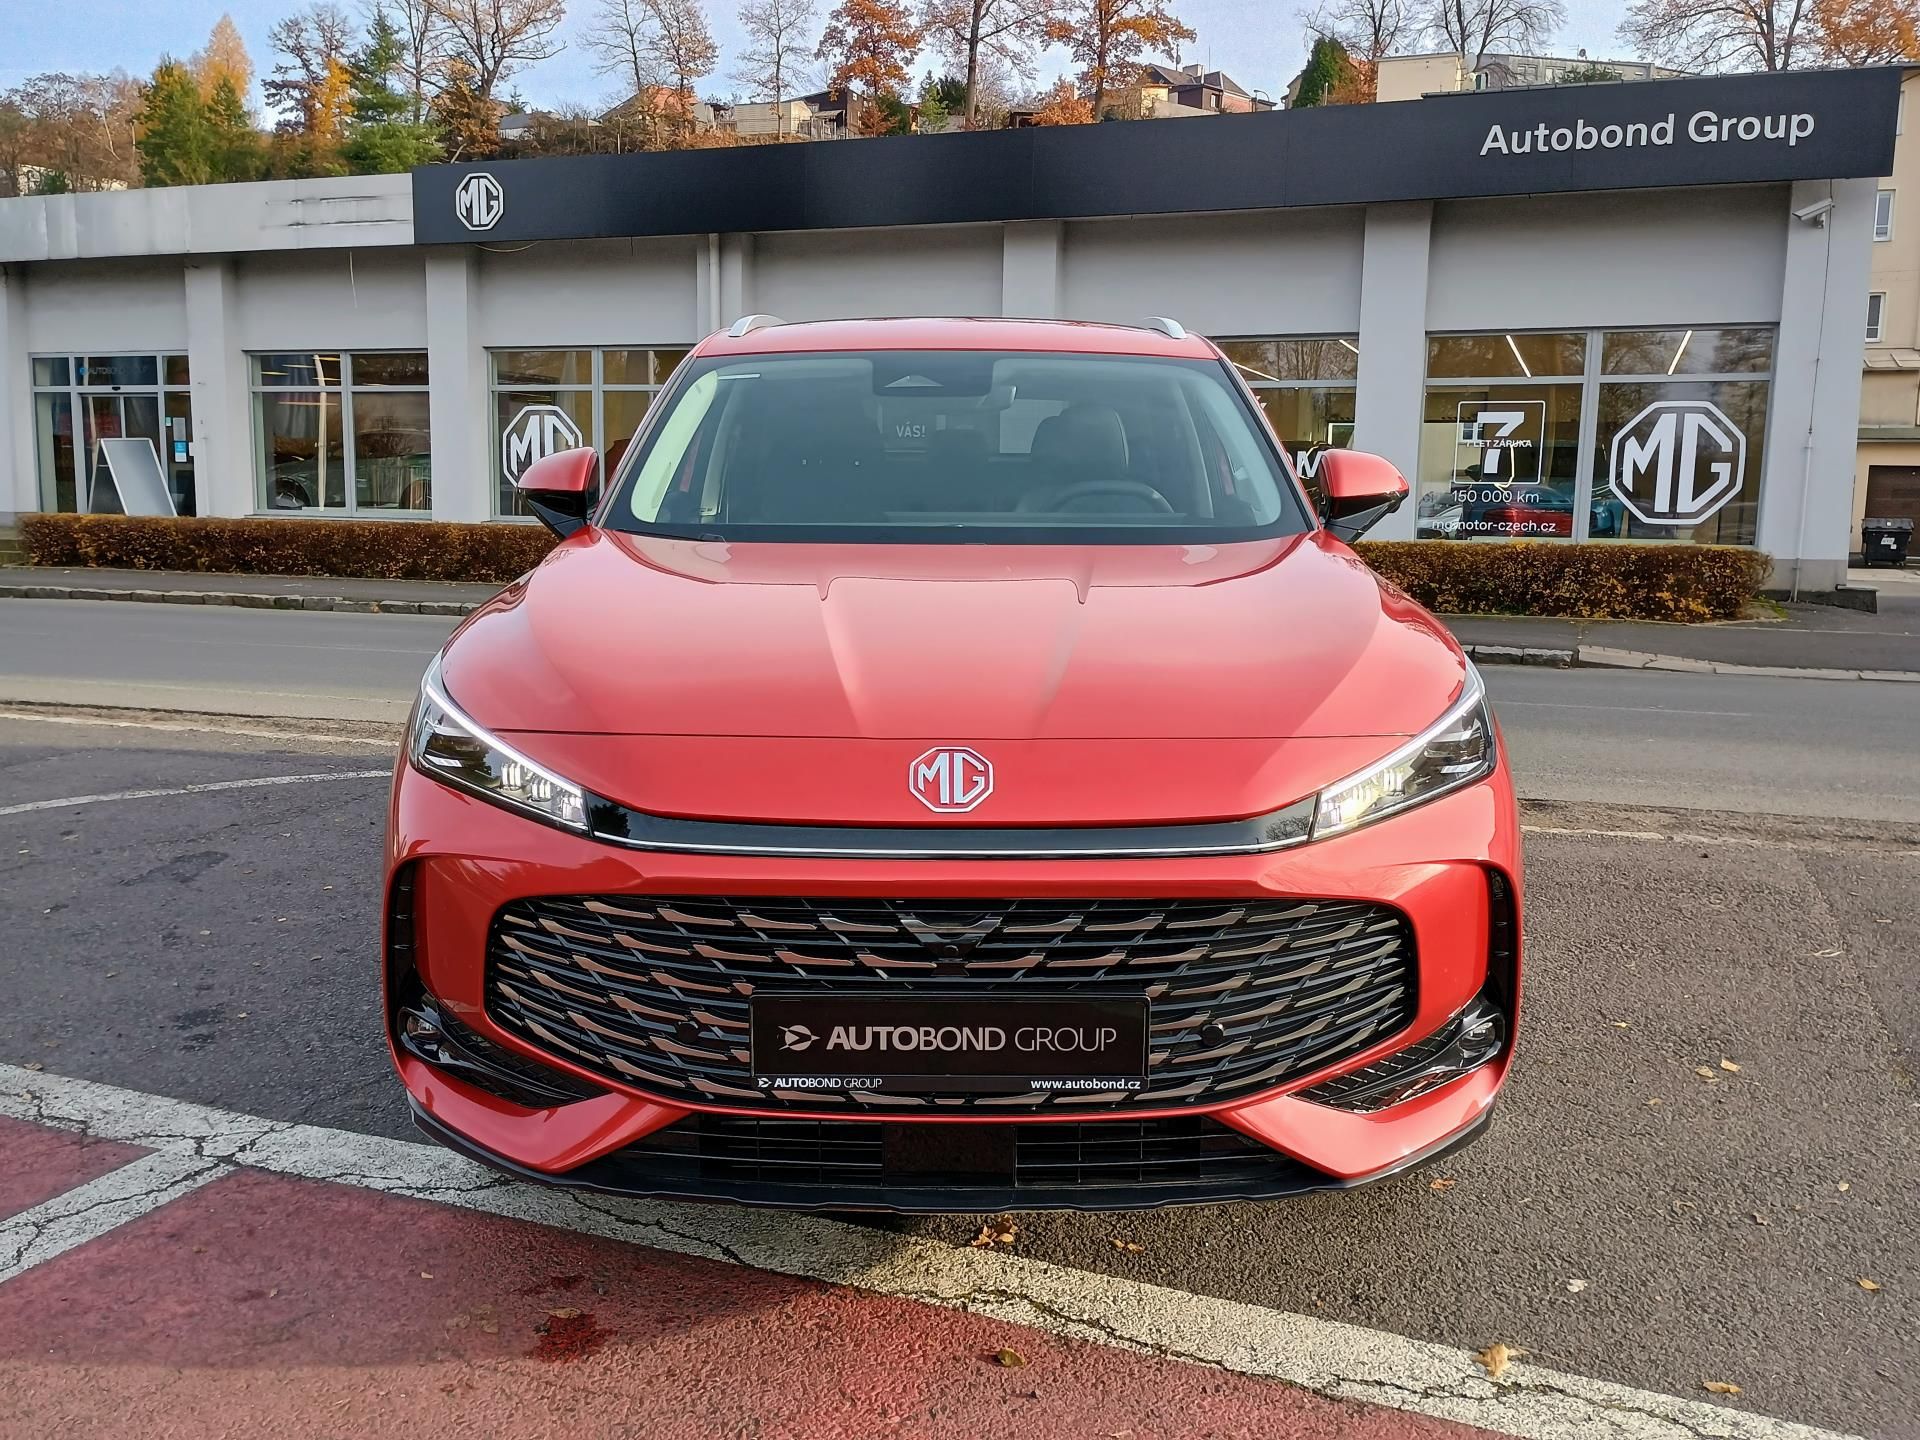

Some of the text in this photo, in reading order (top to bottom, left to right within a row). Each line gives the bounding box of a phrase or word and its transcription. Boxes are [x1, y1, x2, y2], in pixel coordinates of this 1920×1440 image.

[1480, 110, 1815, 156] Autobond Group
[460, 178, 498, 225] MG
[896, 421, 926, 438] VÁS!
[1622, 412, 1733, 513] MG
[1452, 490, 1540, 503] 150 000 km
[918, 752, 985, 805] MG
[826, 1026, 1117, 1052] AUTOBOND GROUP
[774, 1077, 883, 1088] AUTOBOND GROUP
[1030, 1078, 1141, 1090] www.autobond.cz
